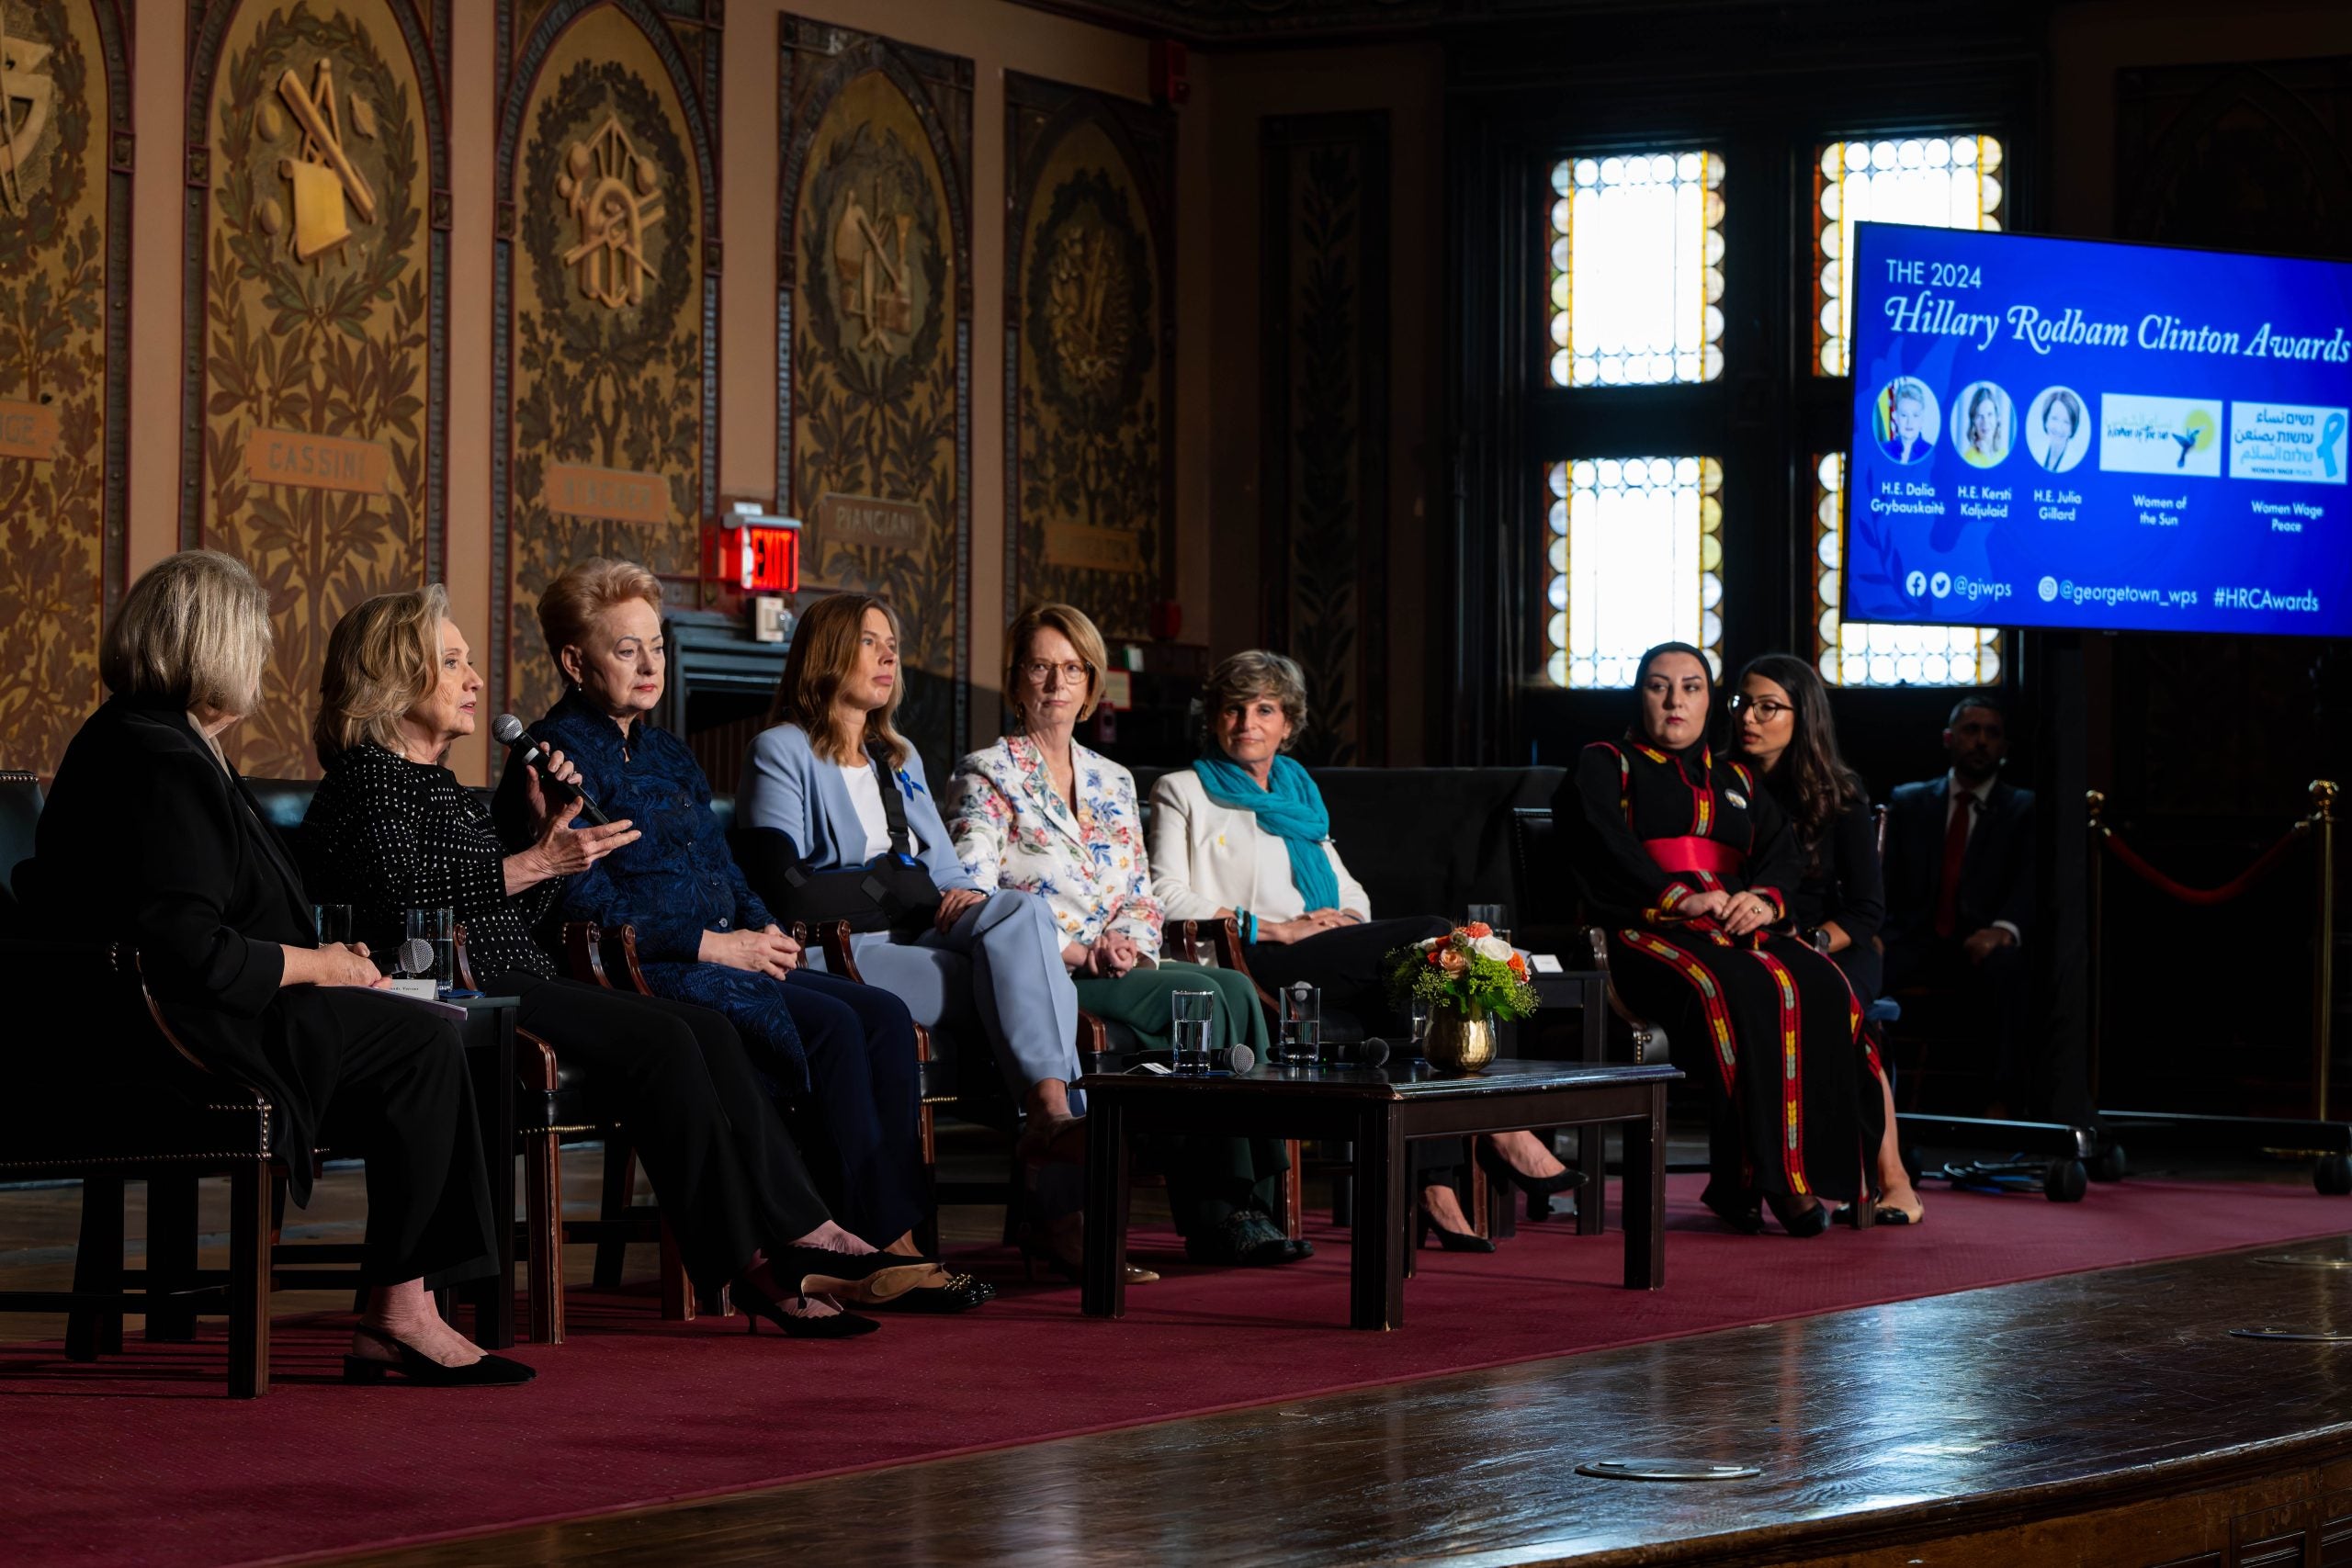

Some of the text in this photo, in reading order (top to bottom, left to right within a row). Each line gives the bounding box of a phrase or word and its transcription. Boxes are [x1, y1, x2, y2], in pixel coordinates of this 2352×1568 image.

[1886, 259, 1982, 289] THE 2024
[1884, 290, 2351, 363] Hillary Rodham Clinton Awards
[267, 441, 367, 482] CASSINI
[1882, 482, 1936, 497] H.E. Dalia
[1958, 486, 2012, 501] H.E. Kersti
[2033, 490, 2082, 504] H.E. Julia
[2132, 494, 2188, 510] Women of
[2251, 500, 2324, 520] Women Wage
[1960, 503, 2008, 520] Kaljulaid
[2039, 506, 2076, 522] Gillard
[2140, 512, 2178, 526] the Sun
[2271, 518, 2301, 533] Peace
[751, 528, 792, 588] EXIT
[1953, 575, 2012, 602] @giwps
[2059, 579, 2197, 609] @georgetown_wps
[2213, 586, 2320, 613] #HRCAwards
